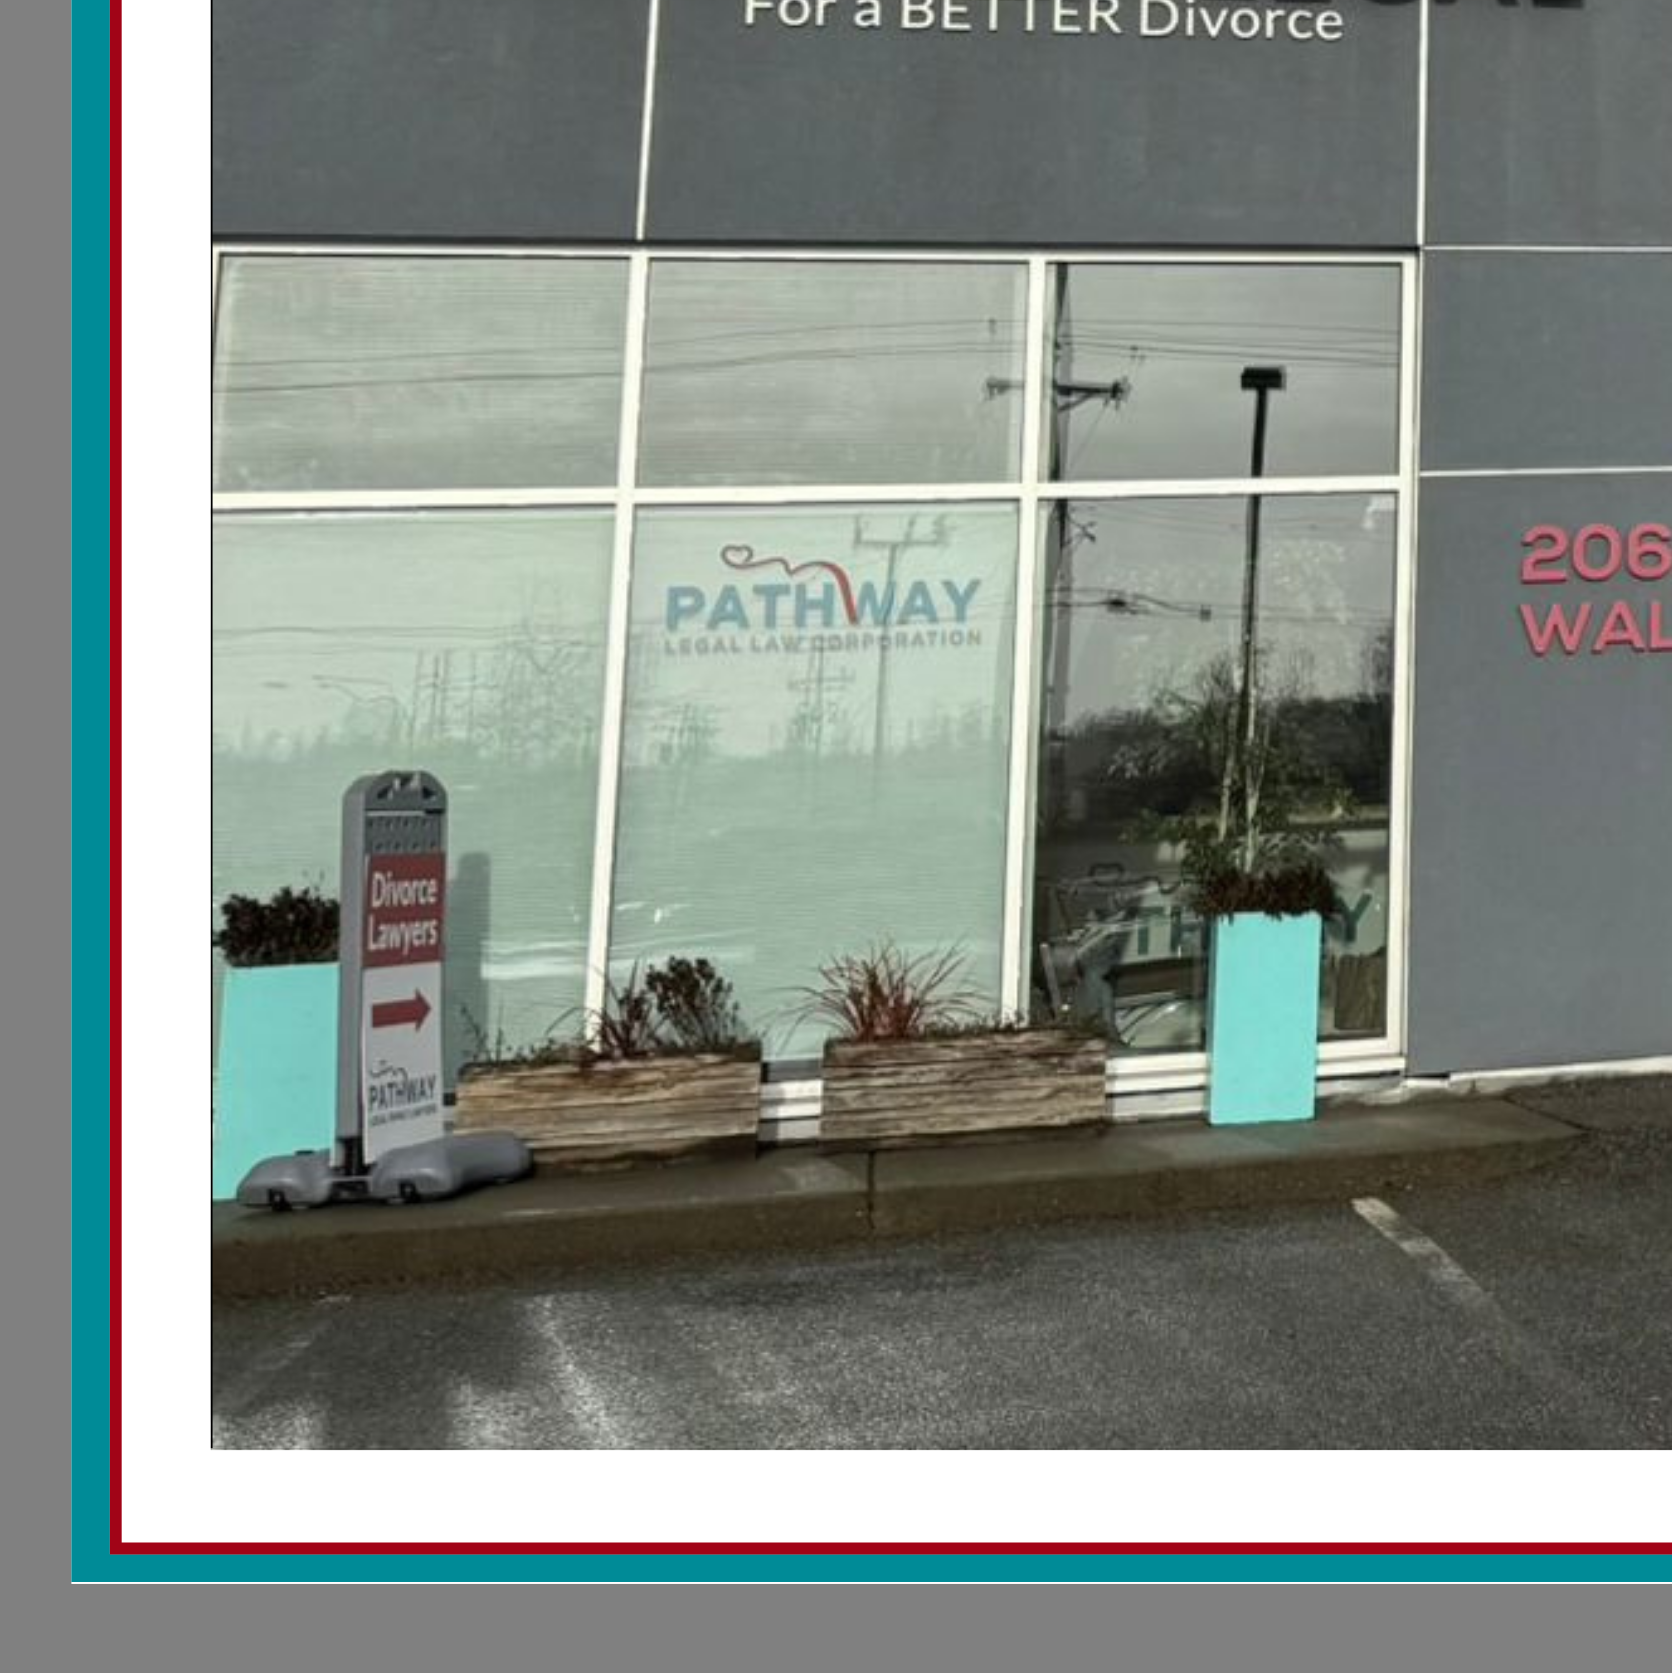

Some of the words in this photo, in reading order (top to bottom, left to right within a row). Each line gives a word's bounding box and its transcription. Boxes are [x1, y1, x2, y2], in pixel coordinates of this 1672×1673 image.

[665, 578, 982, 630] PATHWAY
[664, 634, 742, 656] LEGAL
[751, 634, 803, 654] LAW
[810, 629, 983, 652] CORPORATION
[372, 871, 438, 907] Divorce
[367, 915, 438, 955] Lawyers
[369, 1073, 436, 1111] PATHWAY
